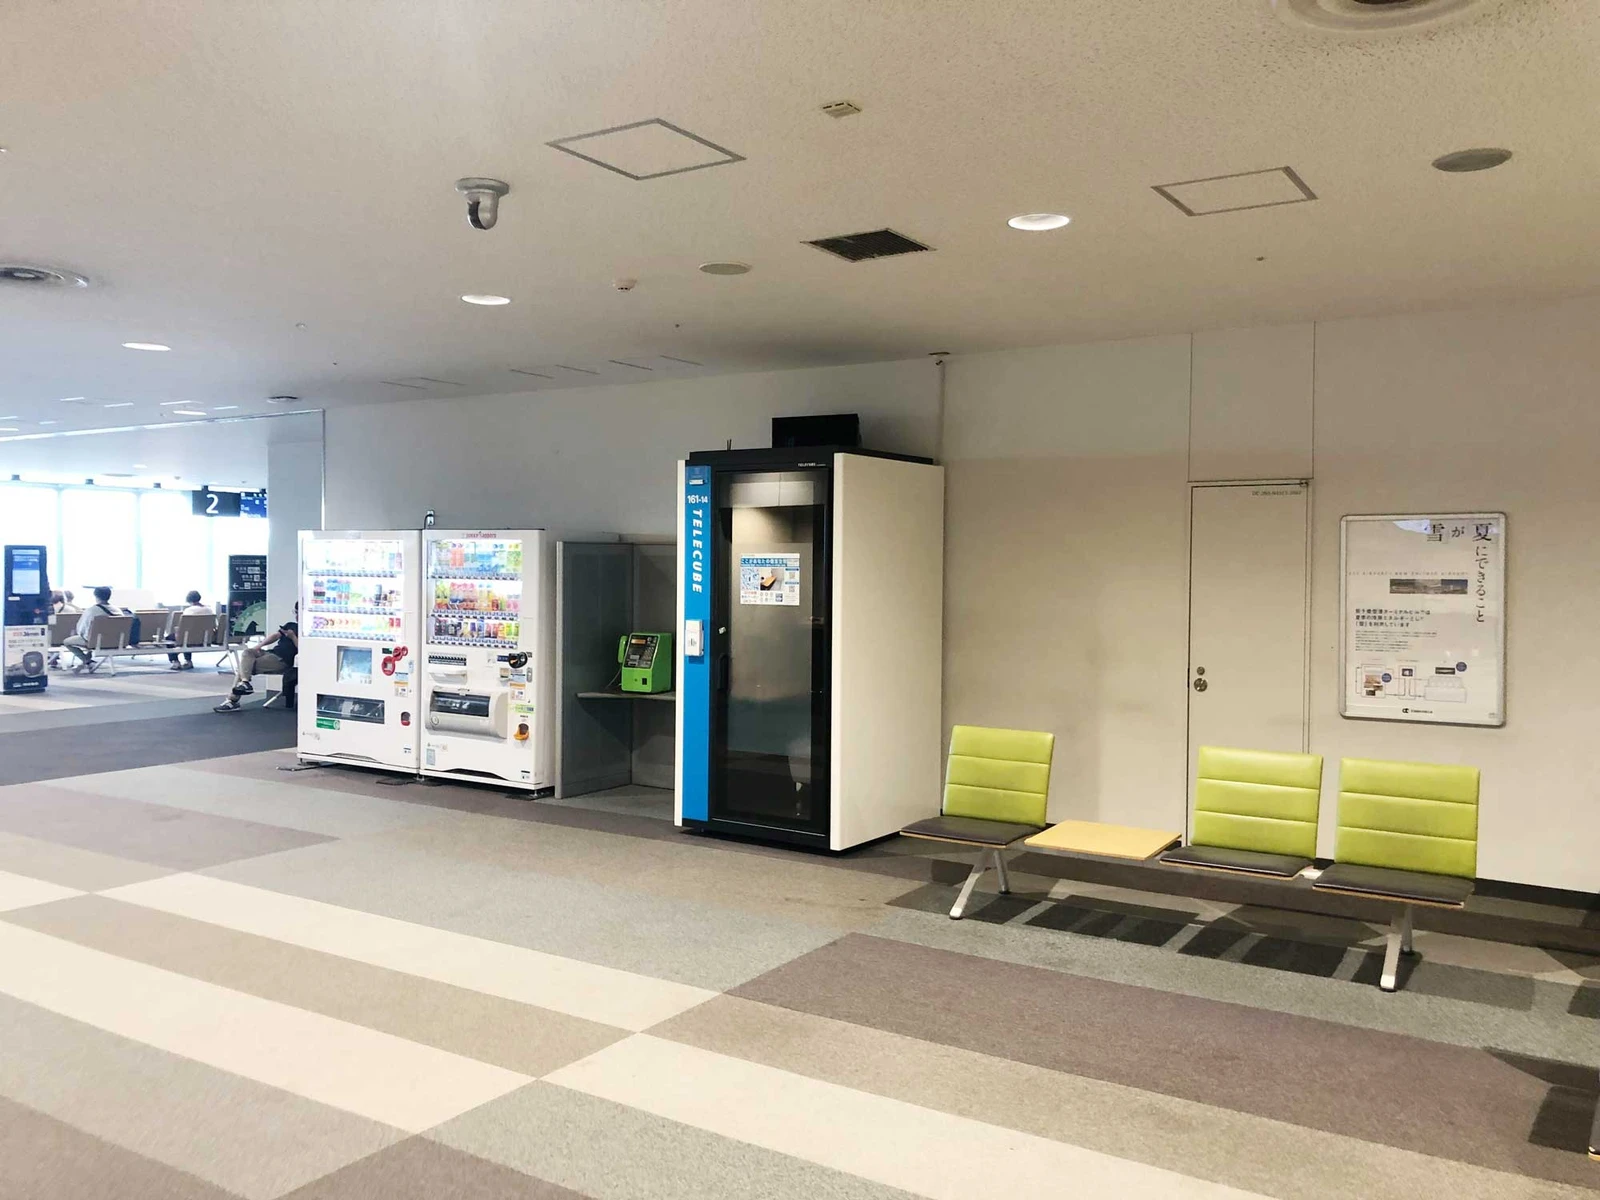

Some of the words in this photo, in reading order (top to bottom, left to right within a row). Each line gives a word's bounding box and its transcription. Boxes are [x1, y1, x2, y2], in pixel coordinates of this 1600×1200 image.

[206, 493, 219, 514] 2
[687, 494, 708, 504] 161-14
[692, 509, 703, 593] TELECUBE
